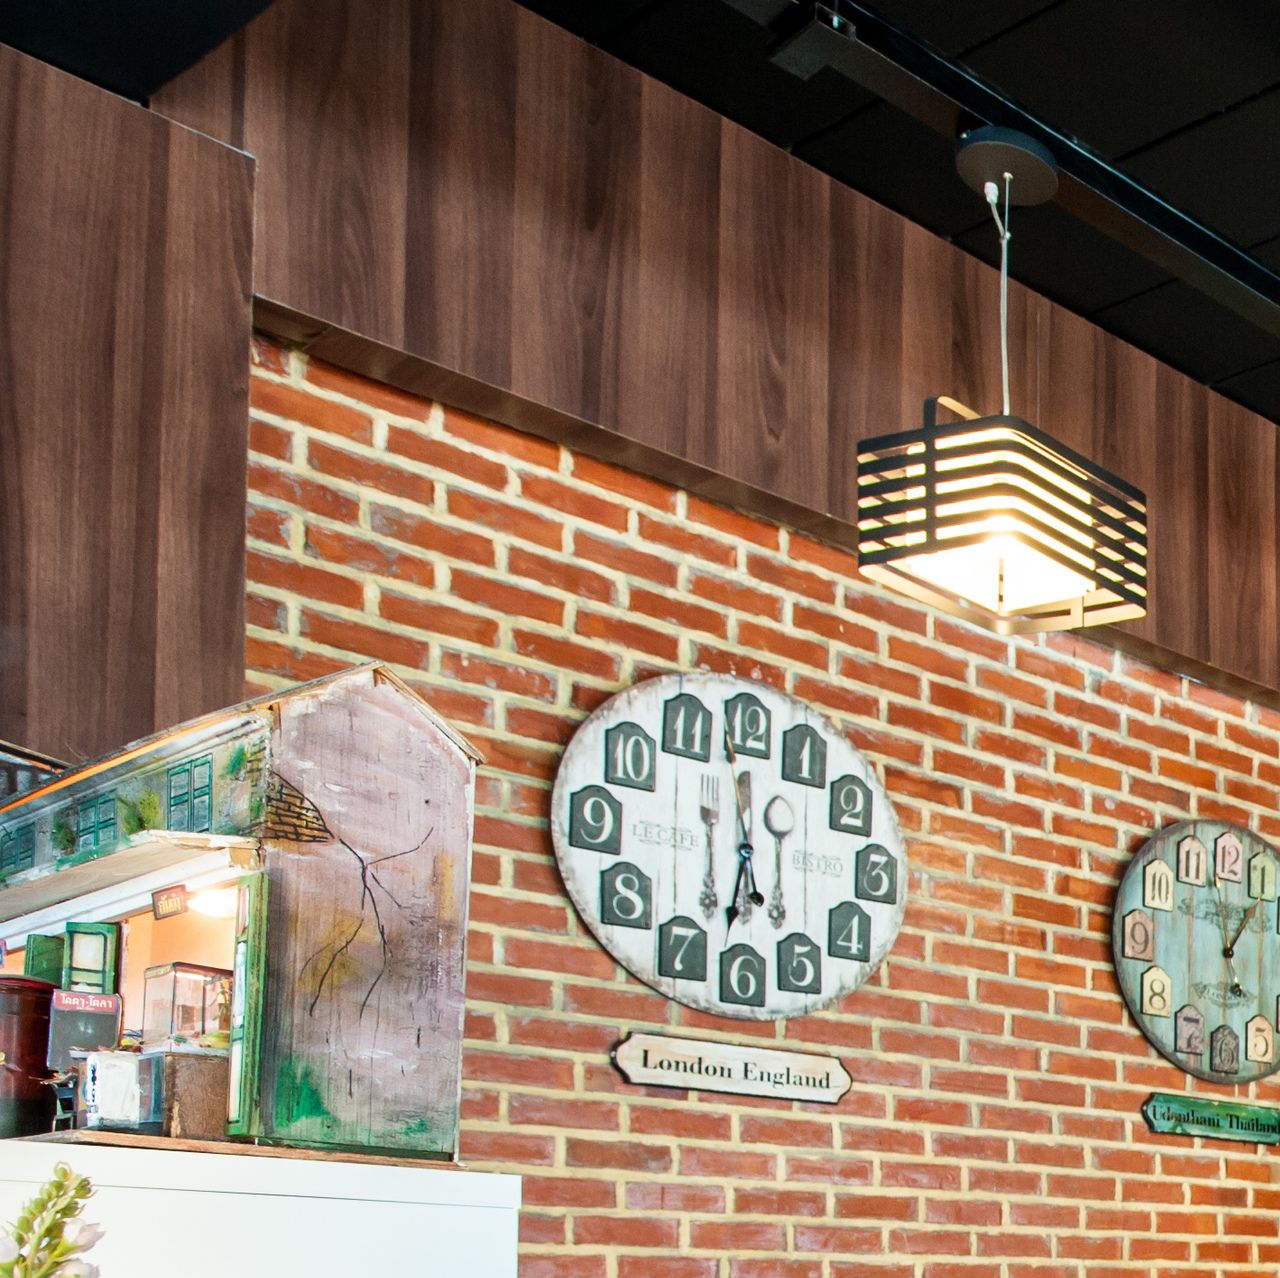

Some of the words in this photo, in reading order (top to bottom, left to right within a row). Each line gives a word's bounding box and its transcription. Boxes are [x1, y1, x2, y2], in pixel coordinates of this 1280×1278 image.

[674, 706, 705, 756] 11
[731, 701, 768, 750] 12
[613, 733, 651, 782] 10
[798, 735, 811, 780] 1
[579, 796, 615, 846] 9
[839, 783, 865, 829] 2
[632, 822, 653, 841] LE
[792, 852, 844, 874] BISTRO
[862, 853, 890, 899] 3
[1185, 849, 1202, 882] 11
[1221, 845, 1240, 877] 12
[1259, 863, 1267, 895] 1
[611, 872, 645, 921] 8
[1150, 870, 1170, 906] 10
[668, 925, 700, 971] 7
[835, 913, 864, 955] 4
[1129, 921, 1150, 955] 9
[729, 954, 757, 1000] 6
[787, 943, 816, 987] 5
[1148, 978, 1167, 1012] 8
[1219, 1036, 1236, 1066] 6
[1253, 1026, 1270, 1058] 5
[640, 1047, 733, 1081] London
[742, 1061, 832, 1091] England
